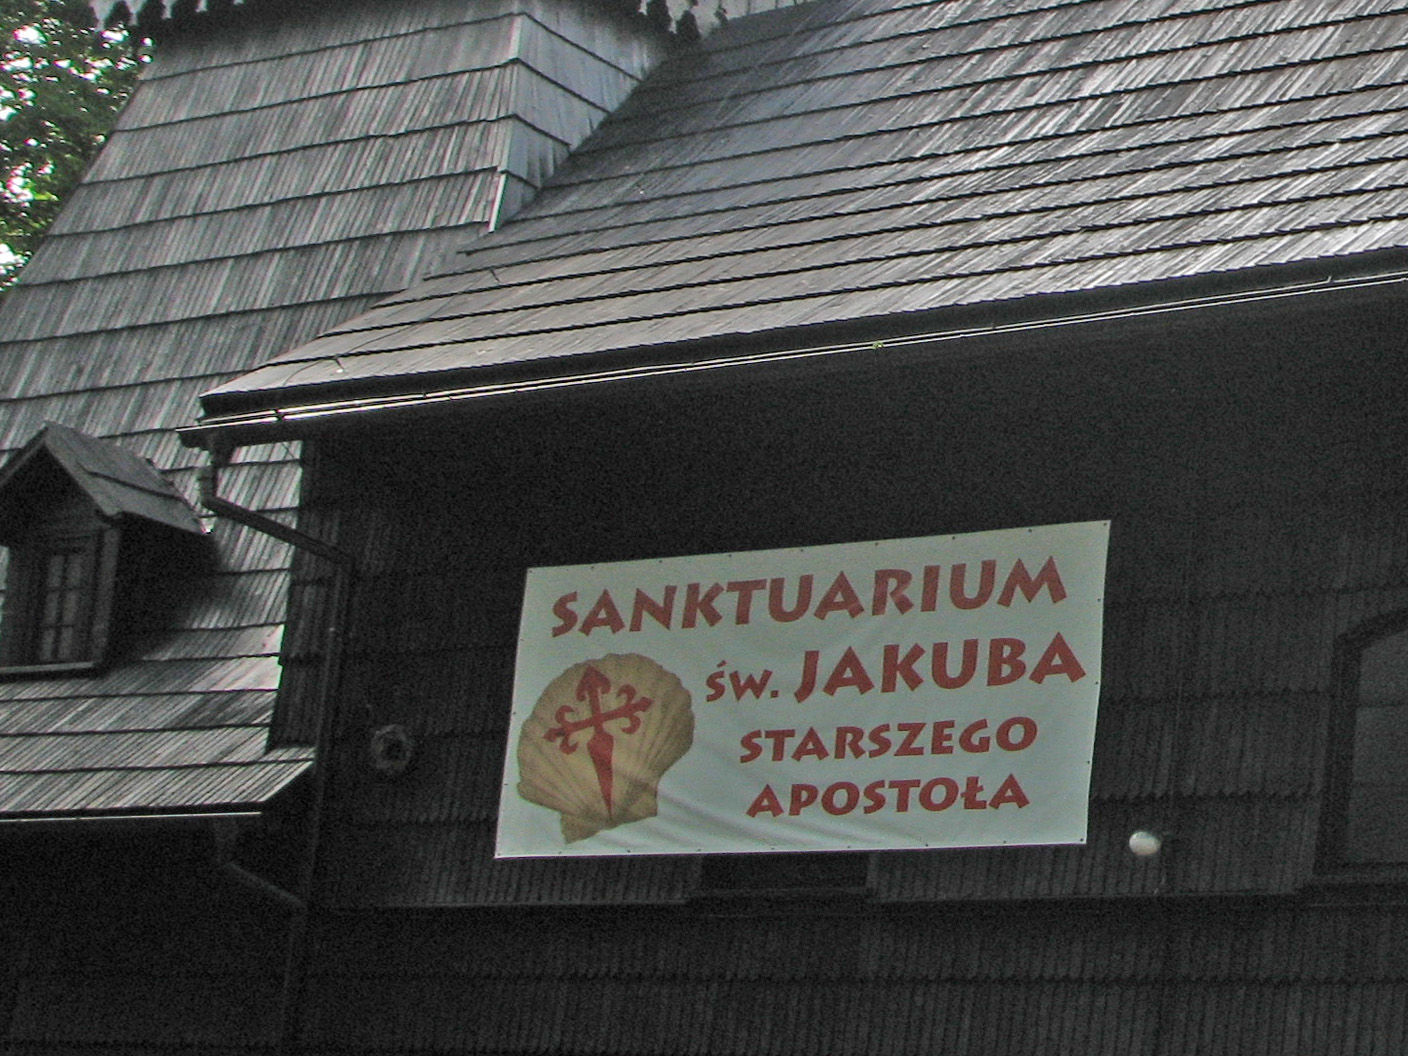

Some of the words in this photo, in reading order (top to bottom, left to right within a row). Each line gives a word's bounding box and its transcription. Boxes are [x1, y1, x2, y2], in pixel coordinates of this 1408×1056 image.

[552, 555, 1068, 639] SANKTUARIUM
[794, 631, 1087, 704] JAKUBA
[740, 716, 1039, 764] STARSZEGO
[746, 773, 1031, 819] APOSTOŁA
